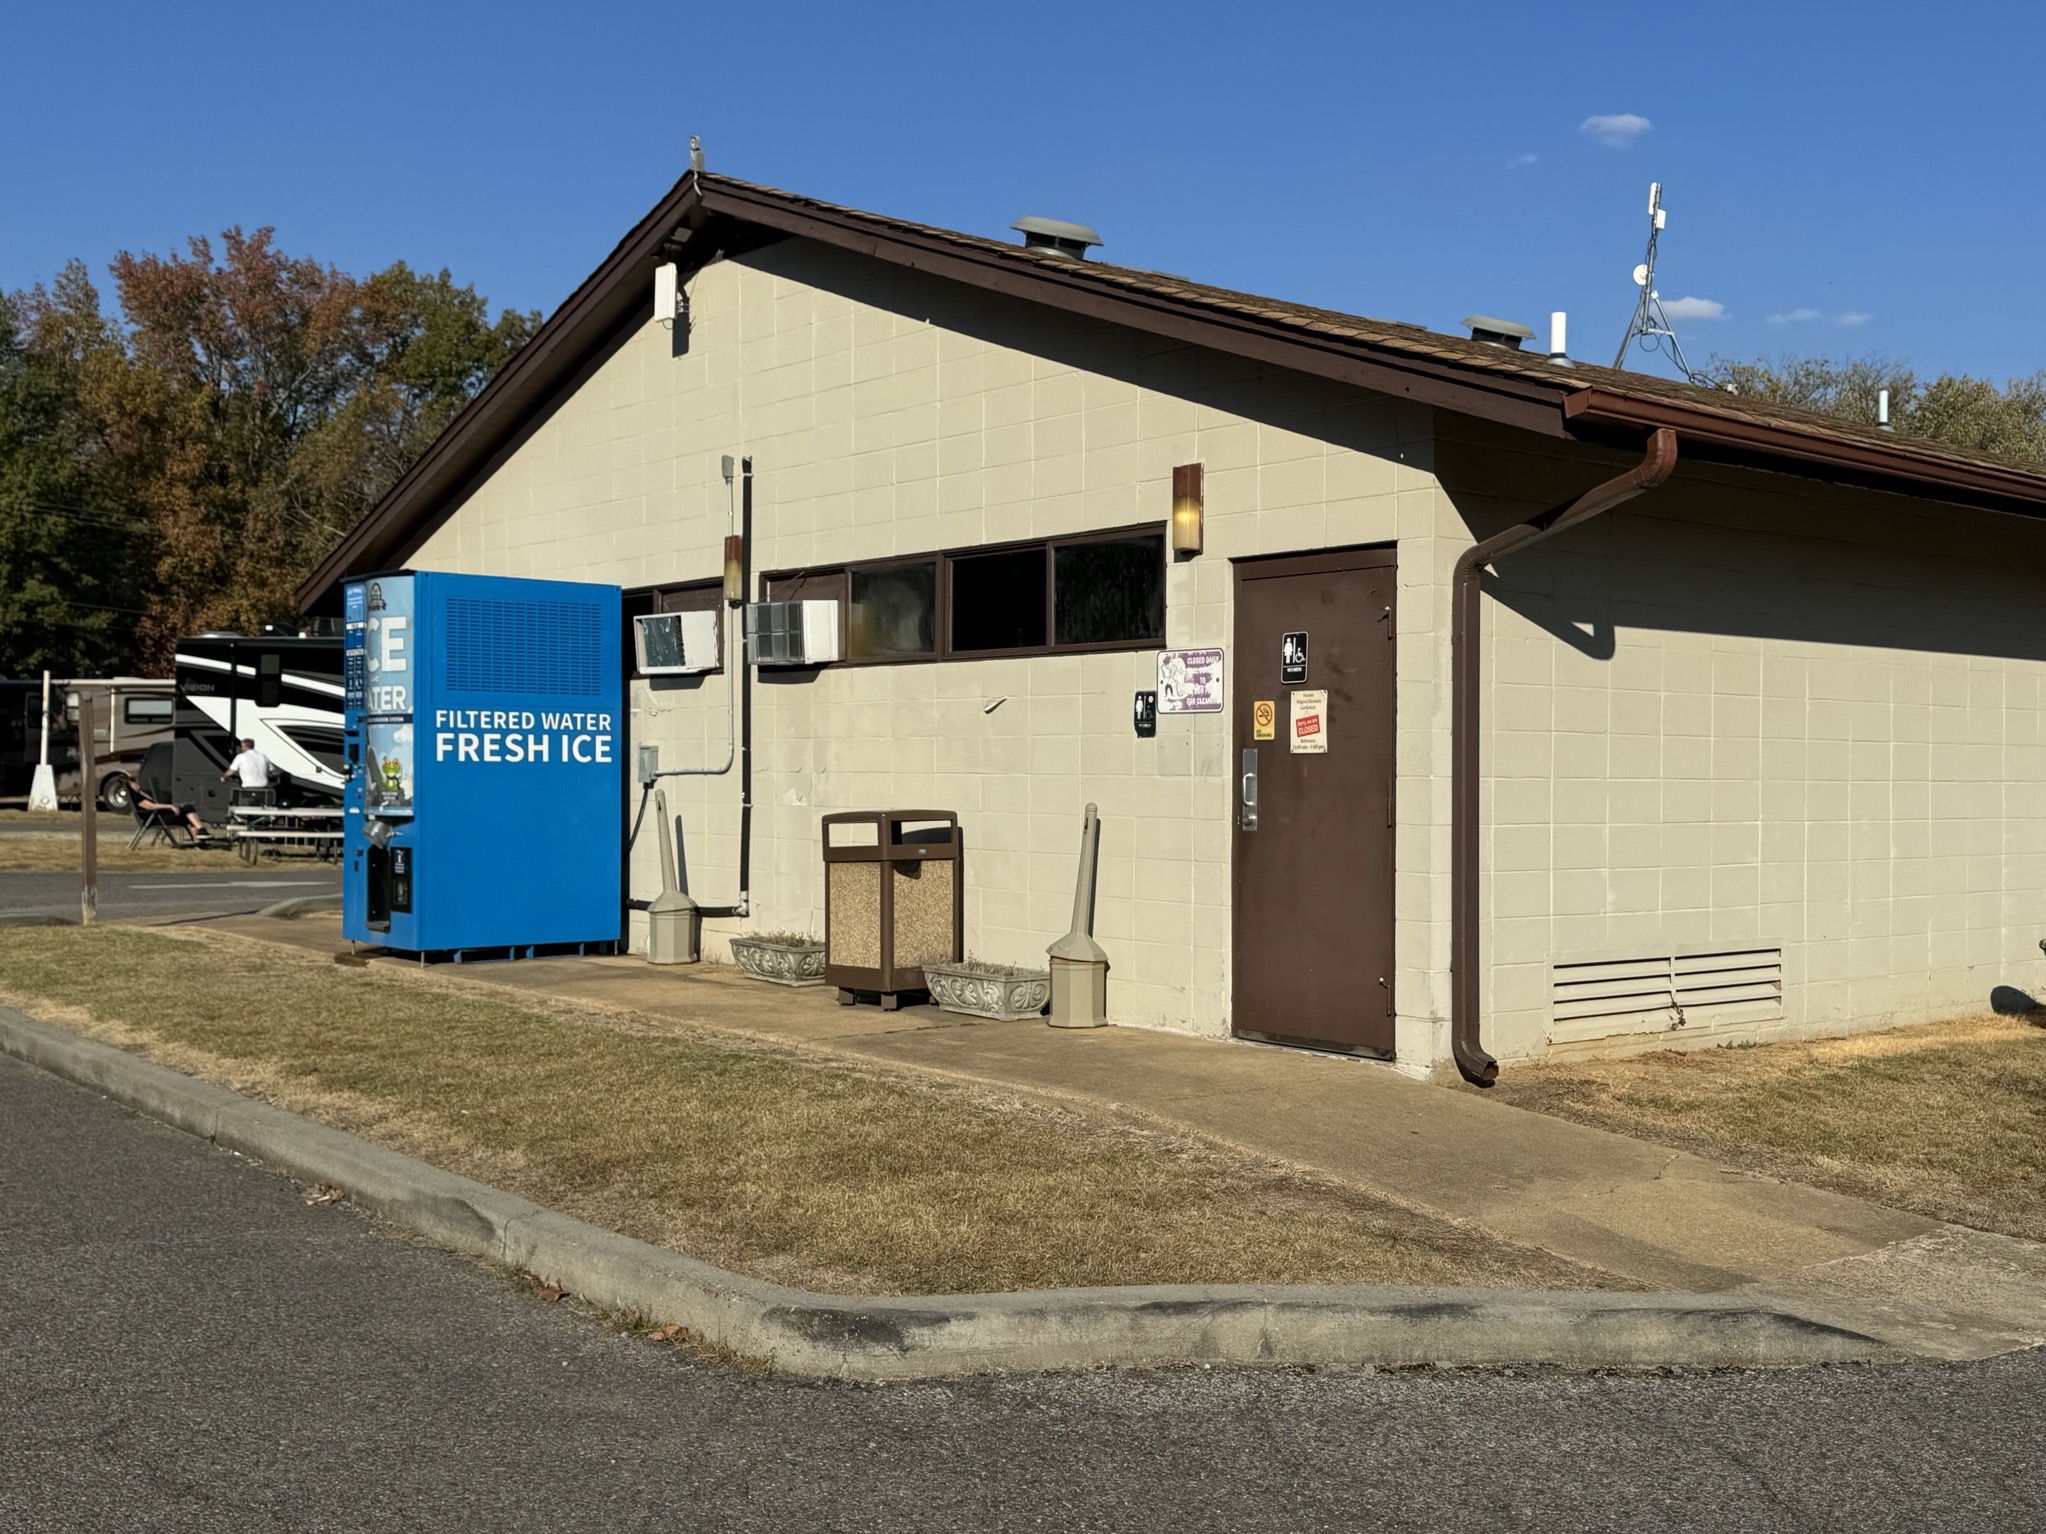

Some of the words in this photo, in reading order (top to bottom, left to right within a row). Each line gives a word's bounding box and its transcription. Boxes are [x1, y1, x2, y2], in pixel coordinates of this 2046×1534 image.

[367, 616, 407, 672] CE
[1186, 656, 1205, 665] CLOSED
[435, 709, 535, 730] FILTERED
[541, 712, 612, 731] WATER
[1298, 723, 1319, 735] CLOSED
[436, 733, 549, 763] FRESH
[562, 734, 612, 763] ICE
